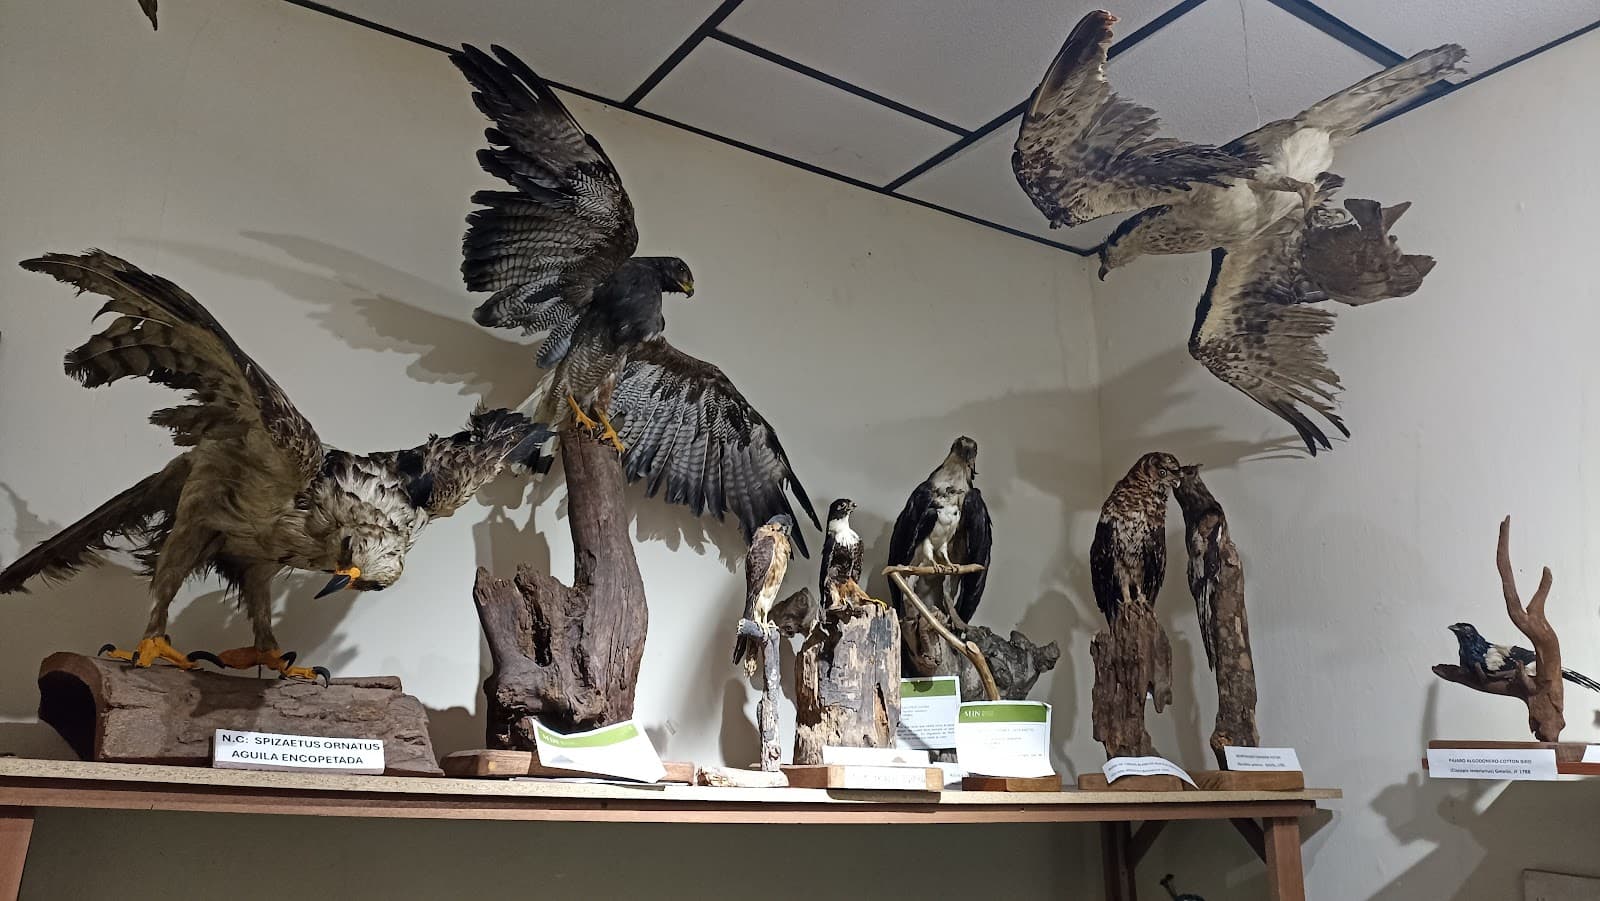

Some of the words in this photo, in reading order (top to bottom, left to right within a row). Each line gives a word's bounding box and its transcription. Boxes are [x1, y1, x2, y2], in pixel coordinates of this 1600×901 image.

[222, 734, 248, 744] N.C:
[255, 737, 320, 748] SPIZAETUS
[324, 741, 380, 750] ORNATUS
[231, 750, 278, 761] AGUILA
[282, 754, 364, 764] ENCOPETADA
